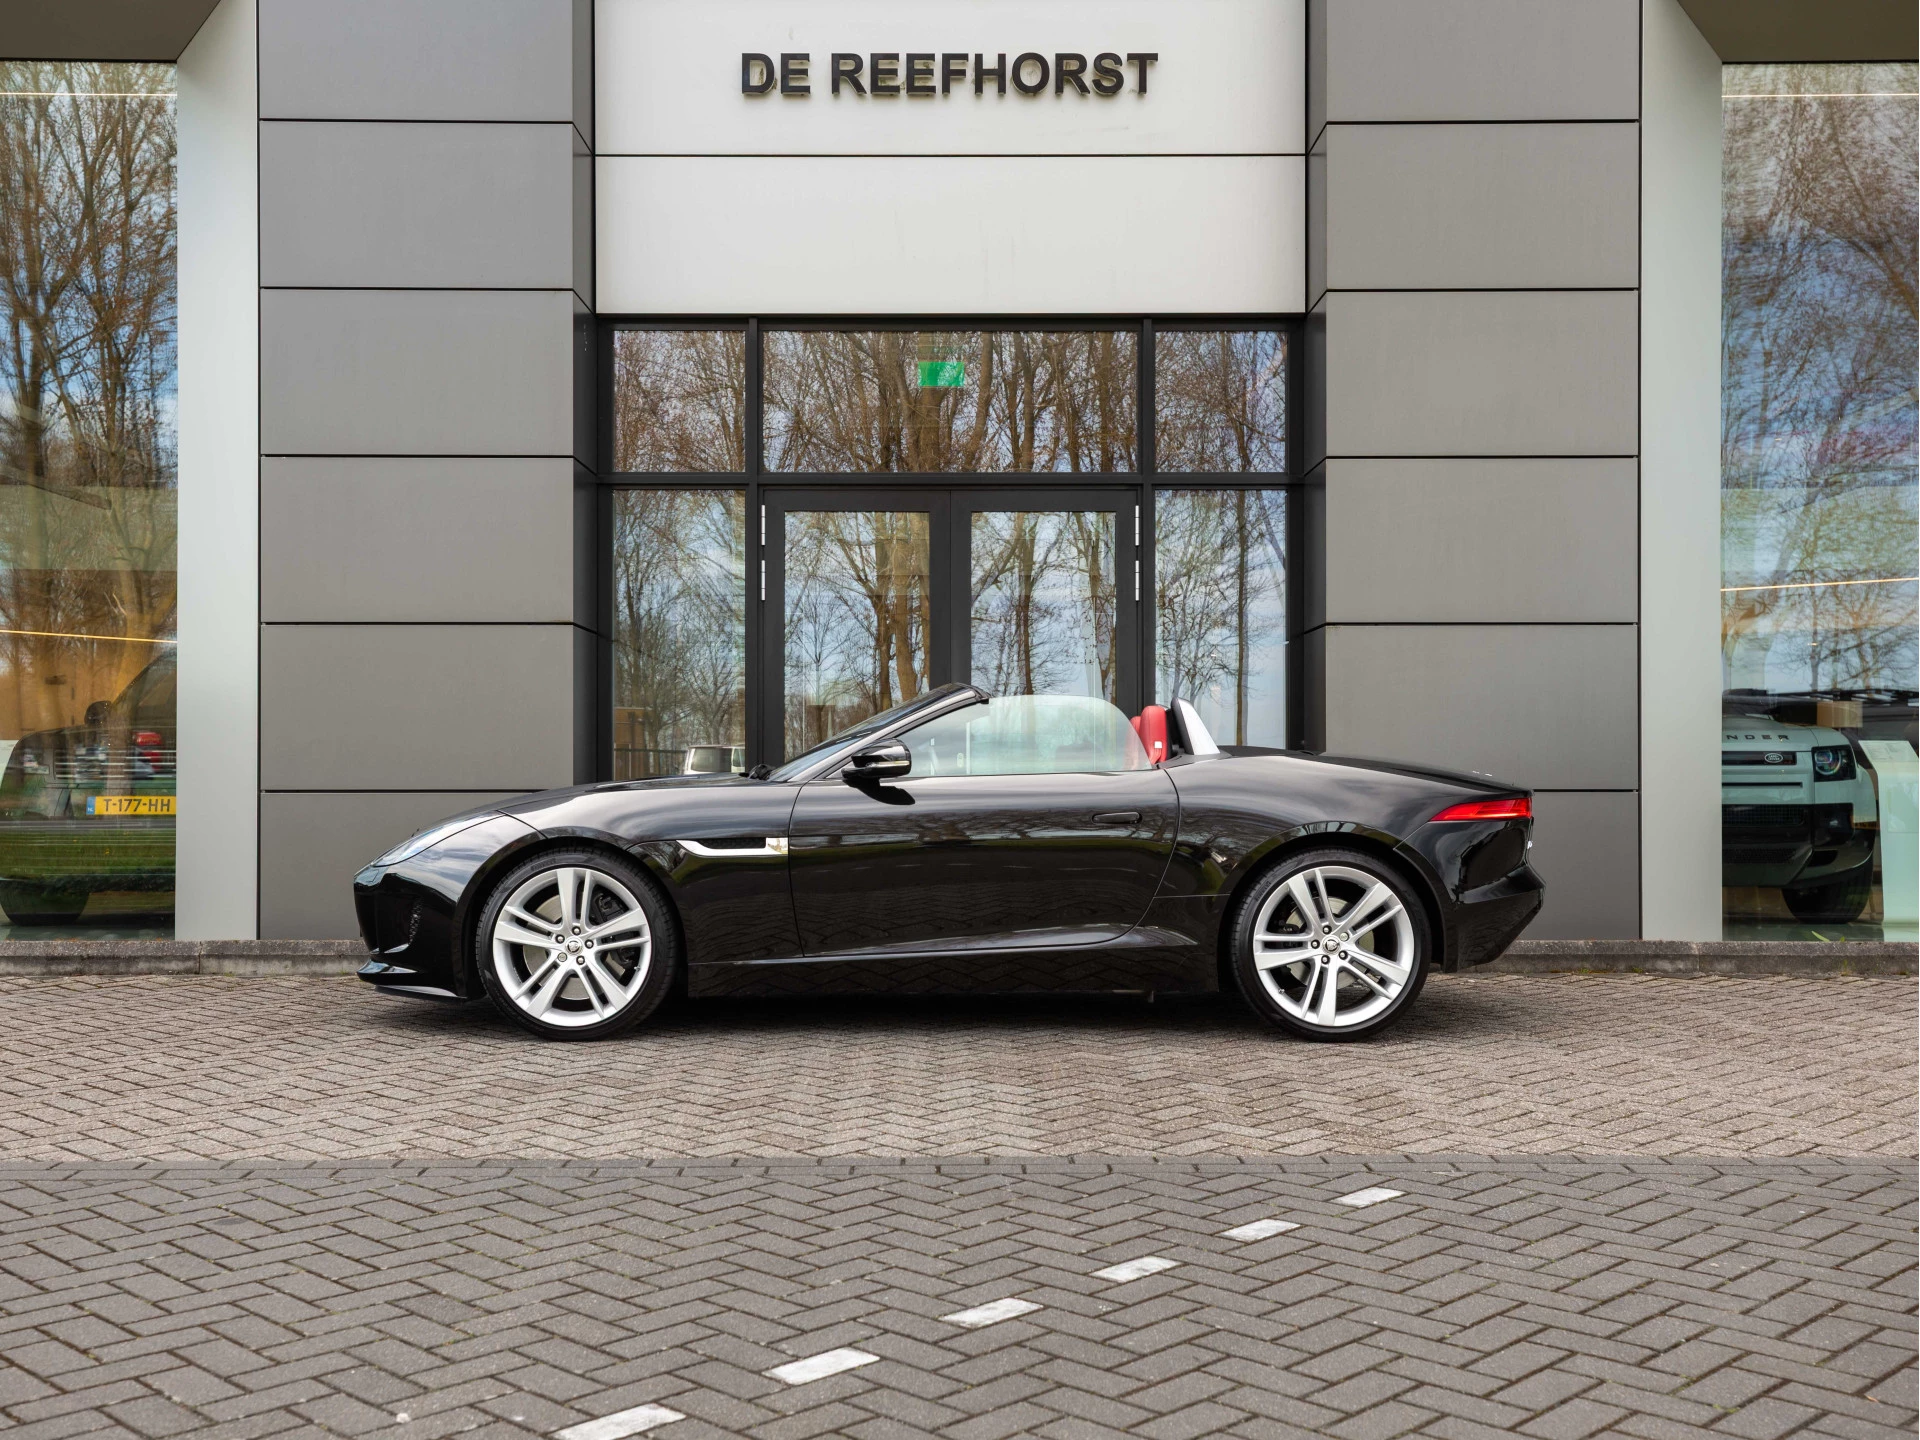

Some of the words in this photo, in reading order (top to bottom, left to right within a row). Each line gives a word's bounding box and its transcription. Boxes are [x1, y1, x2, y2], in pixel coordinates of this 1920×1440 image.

[741, 53, 811, 95] DE
[831, 52, 1159, 95] REEFHORST
[104, 799, 171, 812] T-177-HH
